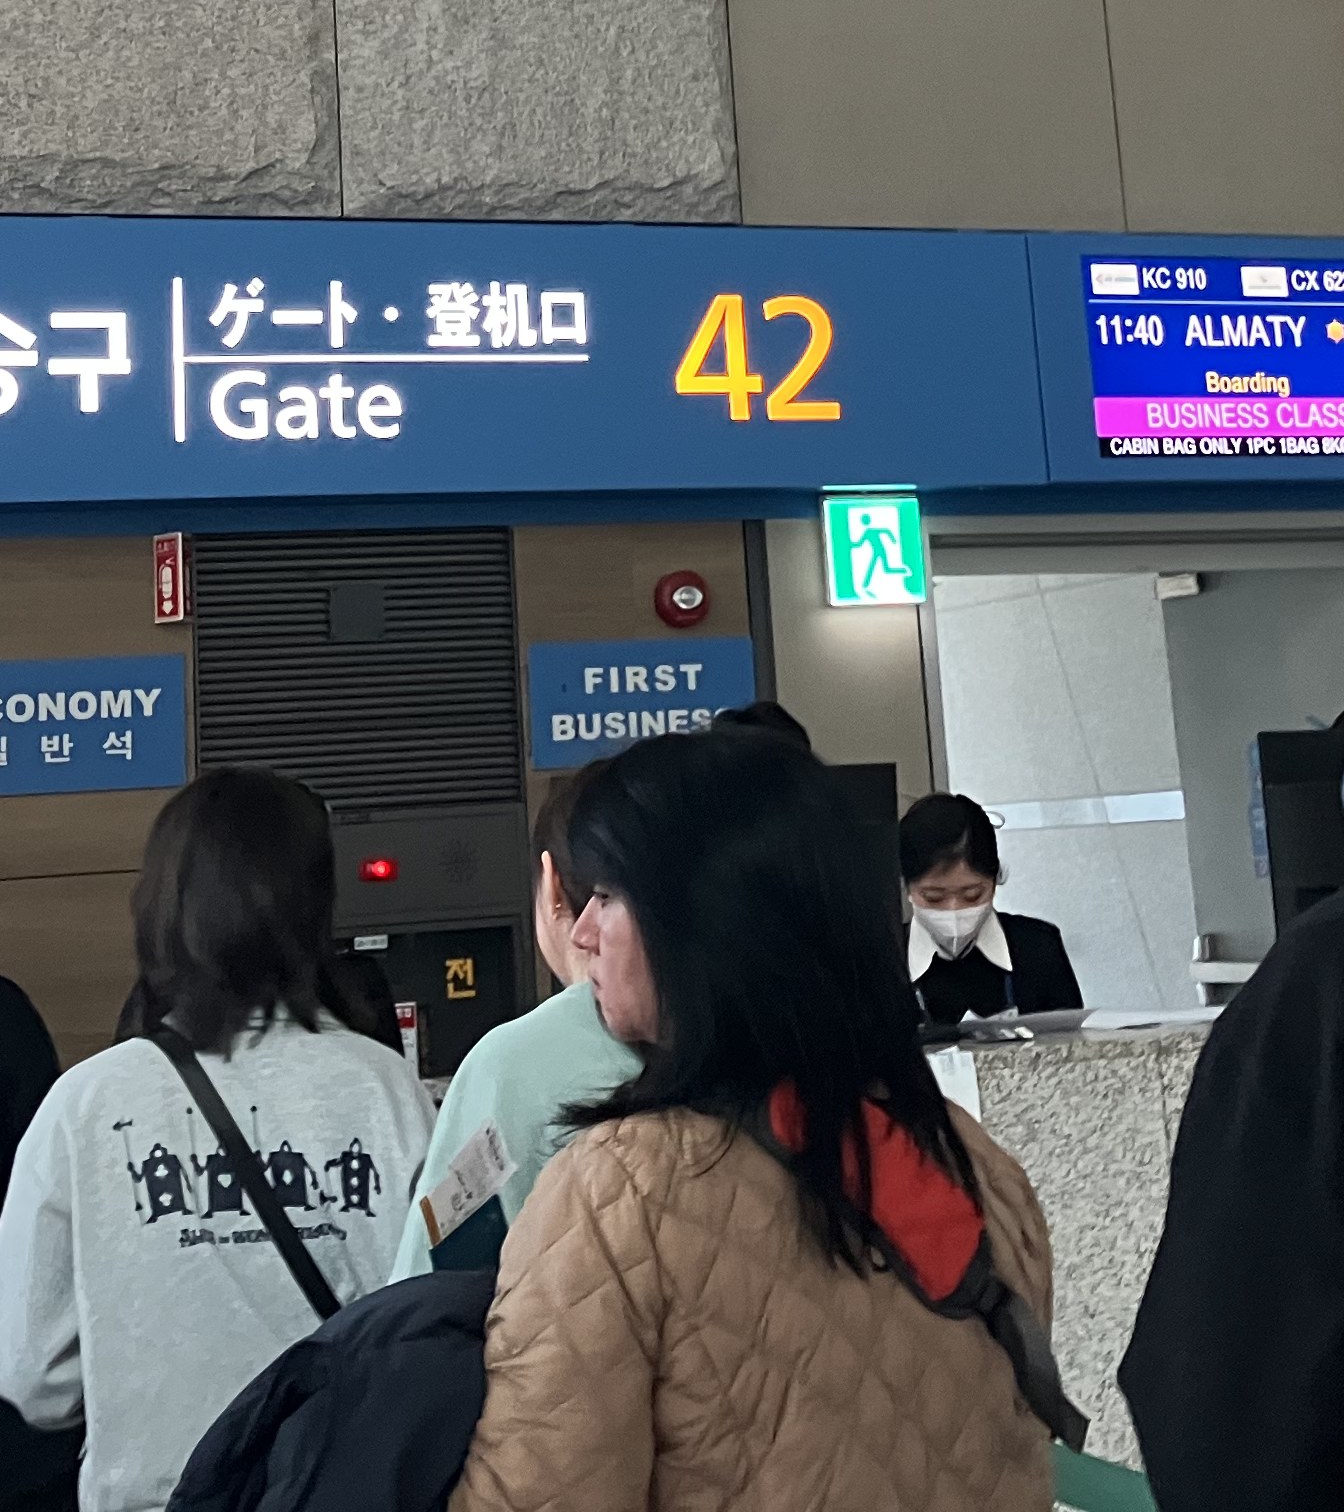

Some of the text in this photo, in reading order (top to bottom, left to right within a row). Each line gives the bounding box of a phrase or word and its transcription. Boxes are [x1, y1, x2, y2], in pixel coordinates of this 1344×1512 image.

[1142, 267, 1171, 289] KC
[1176, 268, 1207, 290] 910
[1291, 269, 1320, 291] CX
[1096, 314, 1306, 347] 11:40 ALMATY
[674, 292, 842, 422] 42
[1205, 371, 1290, 398] Boarding
[209, 368, 402, 441] Gate
[1146, 402, 1269, 429] BUSINESS
[1110, 437, 1159, 455] CABIN
[1163, 438, 1197, 455] BAG
[1199, 437, 1242, 454] ONLY
[1246, 437, 1275, 454] 1PC
[1279, 437, 1319, 454] 1BAG
[584, 663, 703, 694] FIRST
[551, 708, 731, 741] BUSINES
[445, 957, 476, 1000] 전
